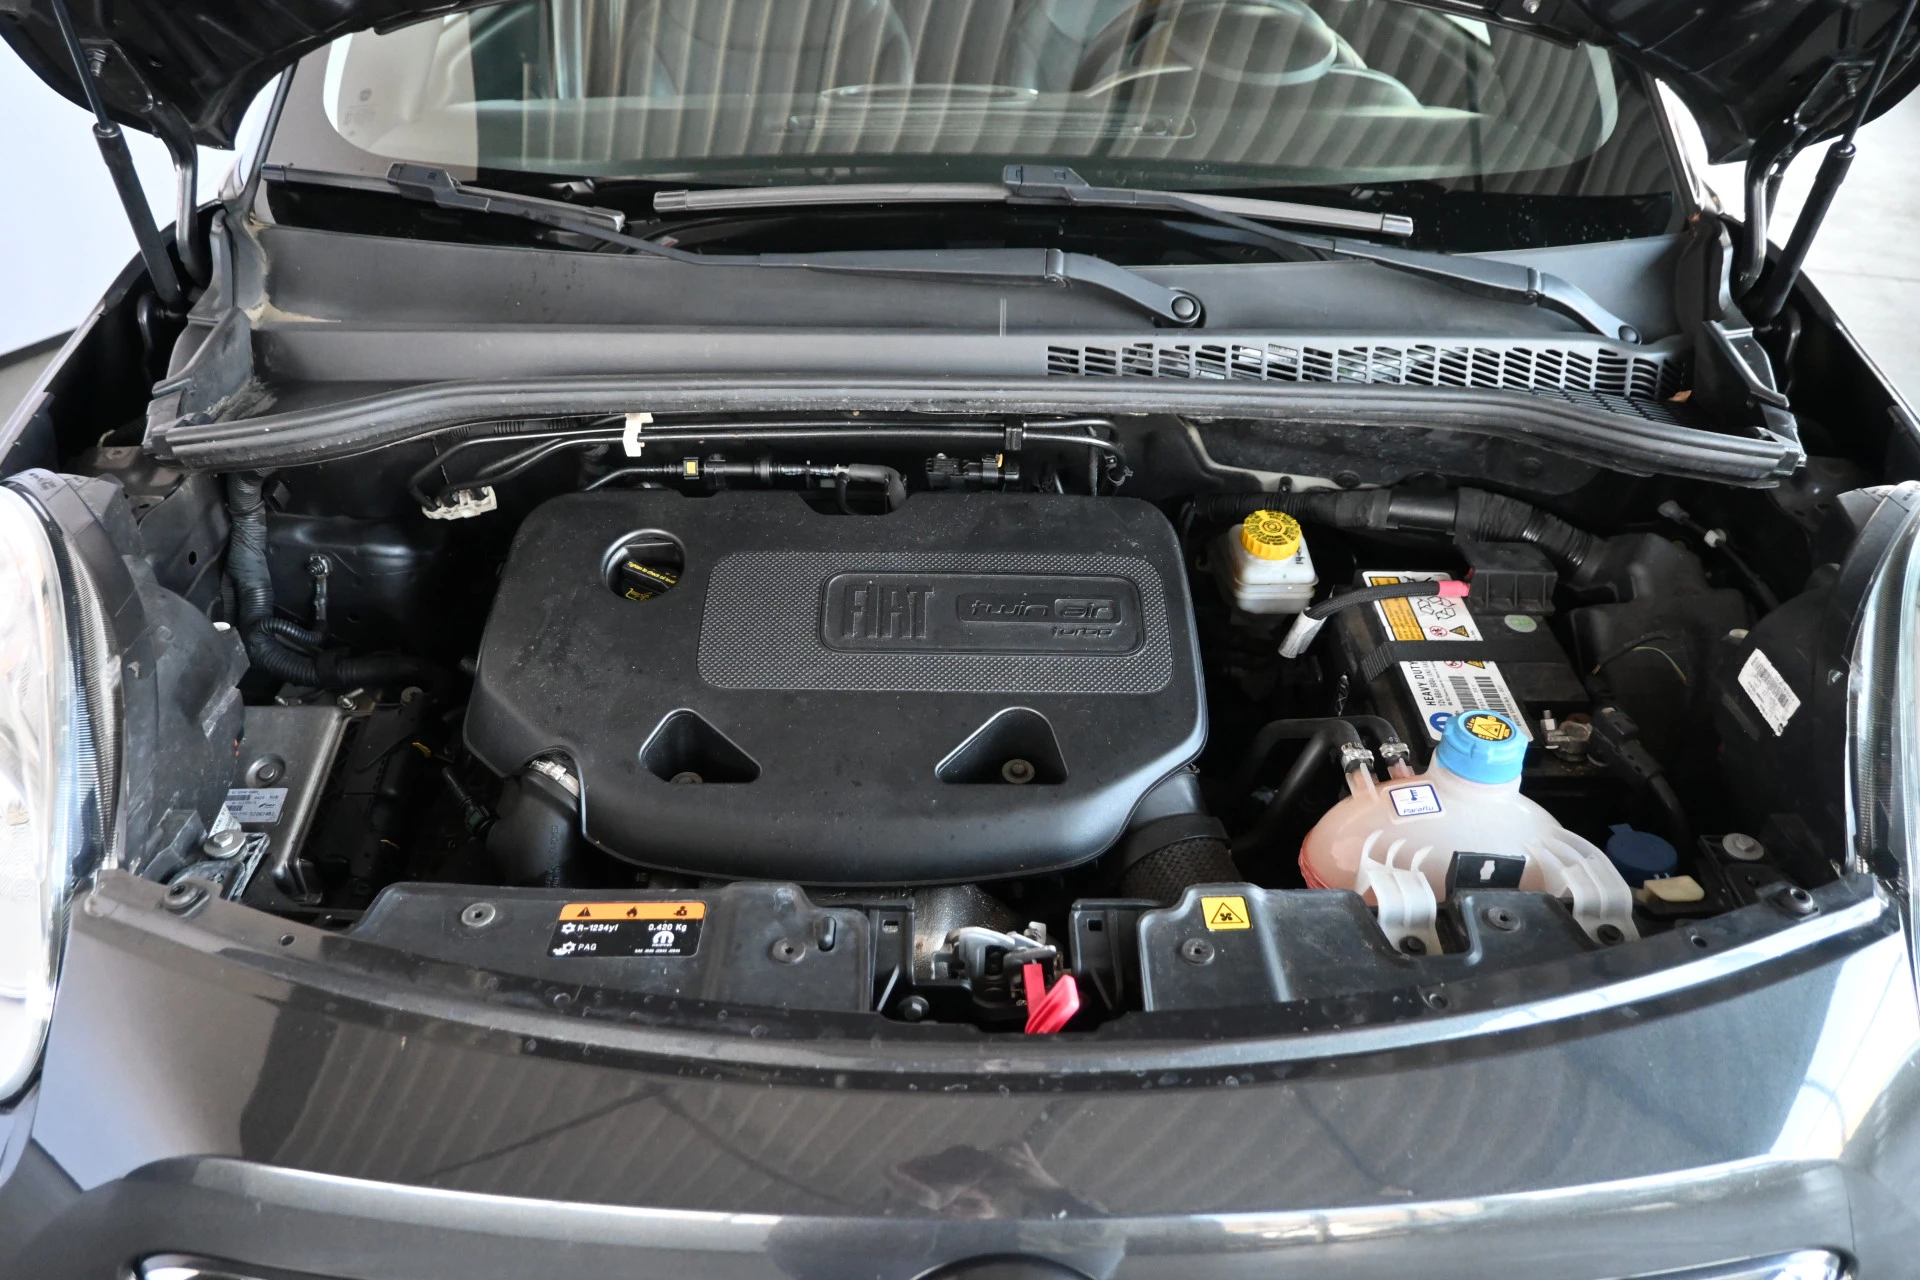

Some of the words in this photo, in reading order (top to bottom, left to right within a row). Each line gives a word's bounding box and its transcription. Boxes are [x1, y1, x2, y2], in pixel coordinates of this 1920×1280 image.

[843, 584, 935, 639] FIAT
[971, 599, 1049, 617] twin
[1062, 602, 1110, 619] air
[1052, 625, 1115, 638] turbo
[1408, 660, 1425, 680] DUTY
[1416, 681, 1437, 706] HEAVY
[577, 923, 619, 933] R-1234yf
[648, 923, 673, 931] 0.420
[675, 923, 687, 932] Kg
